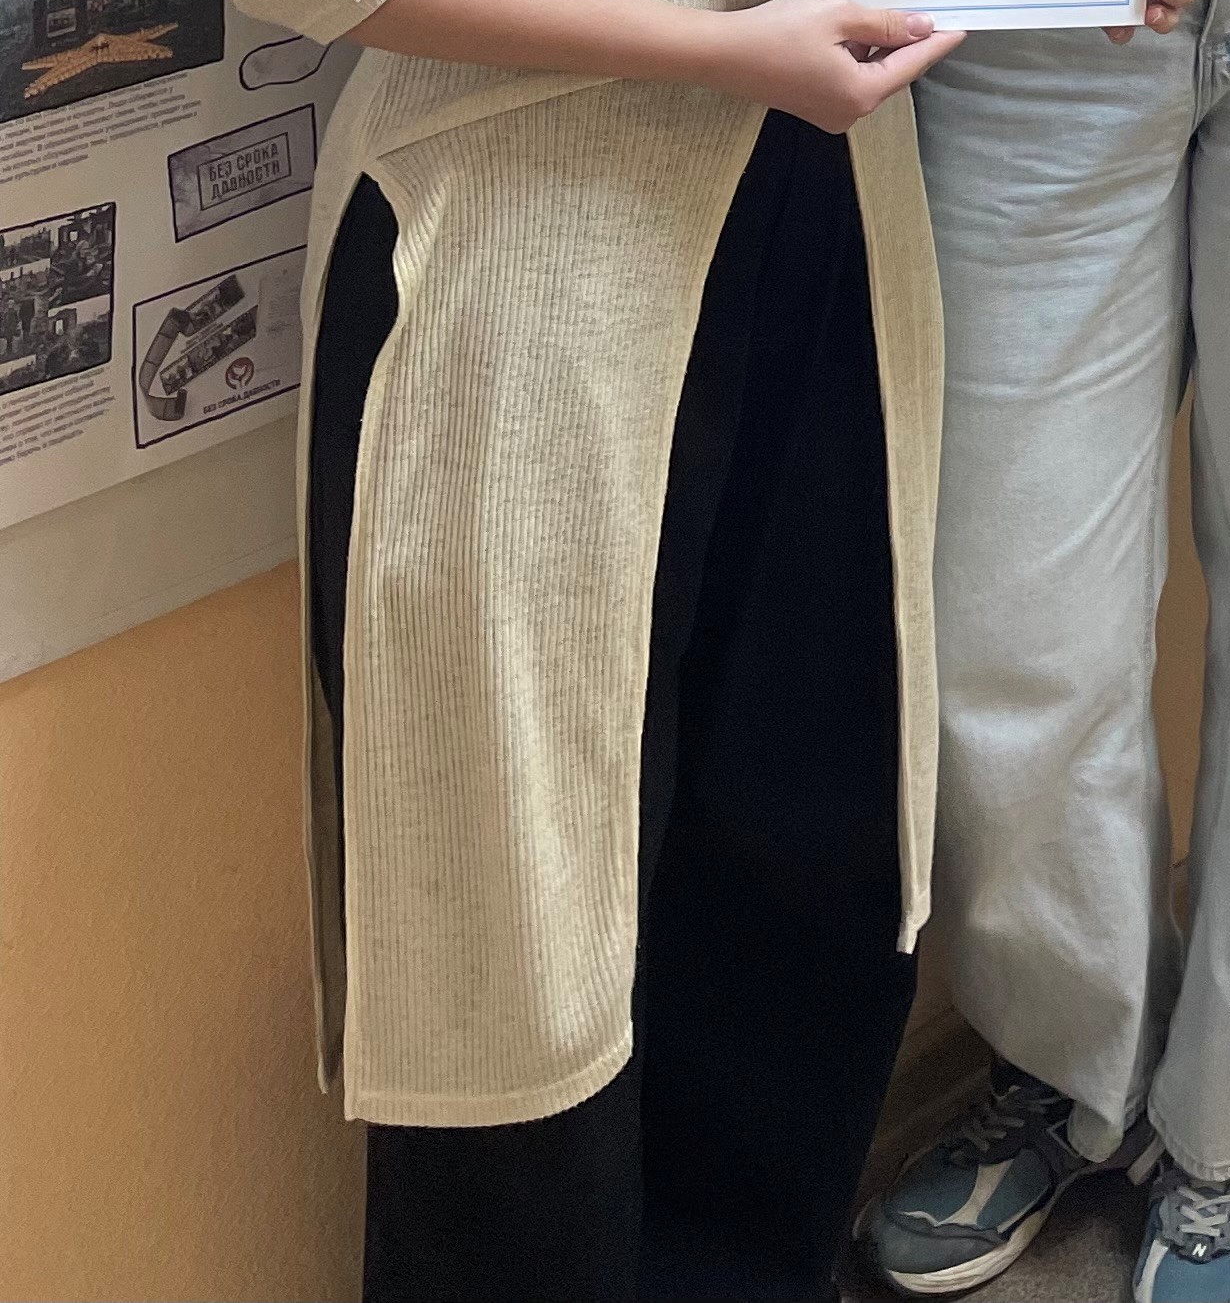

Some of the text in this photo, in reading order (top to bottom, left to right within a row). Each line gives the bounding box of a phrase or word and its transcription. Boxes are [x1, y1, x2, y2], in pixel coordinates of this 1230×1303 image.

[209, 143, 278, 182] БЕЗ СРОКА
[212, 160, 280, 201] ДАВНОСТИ
